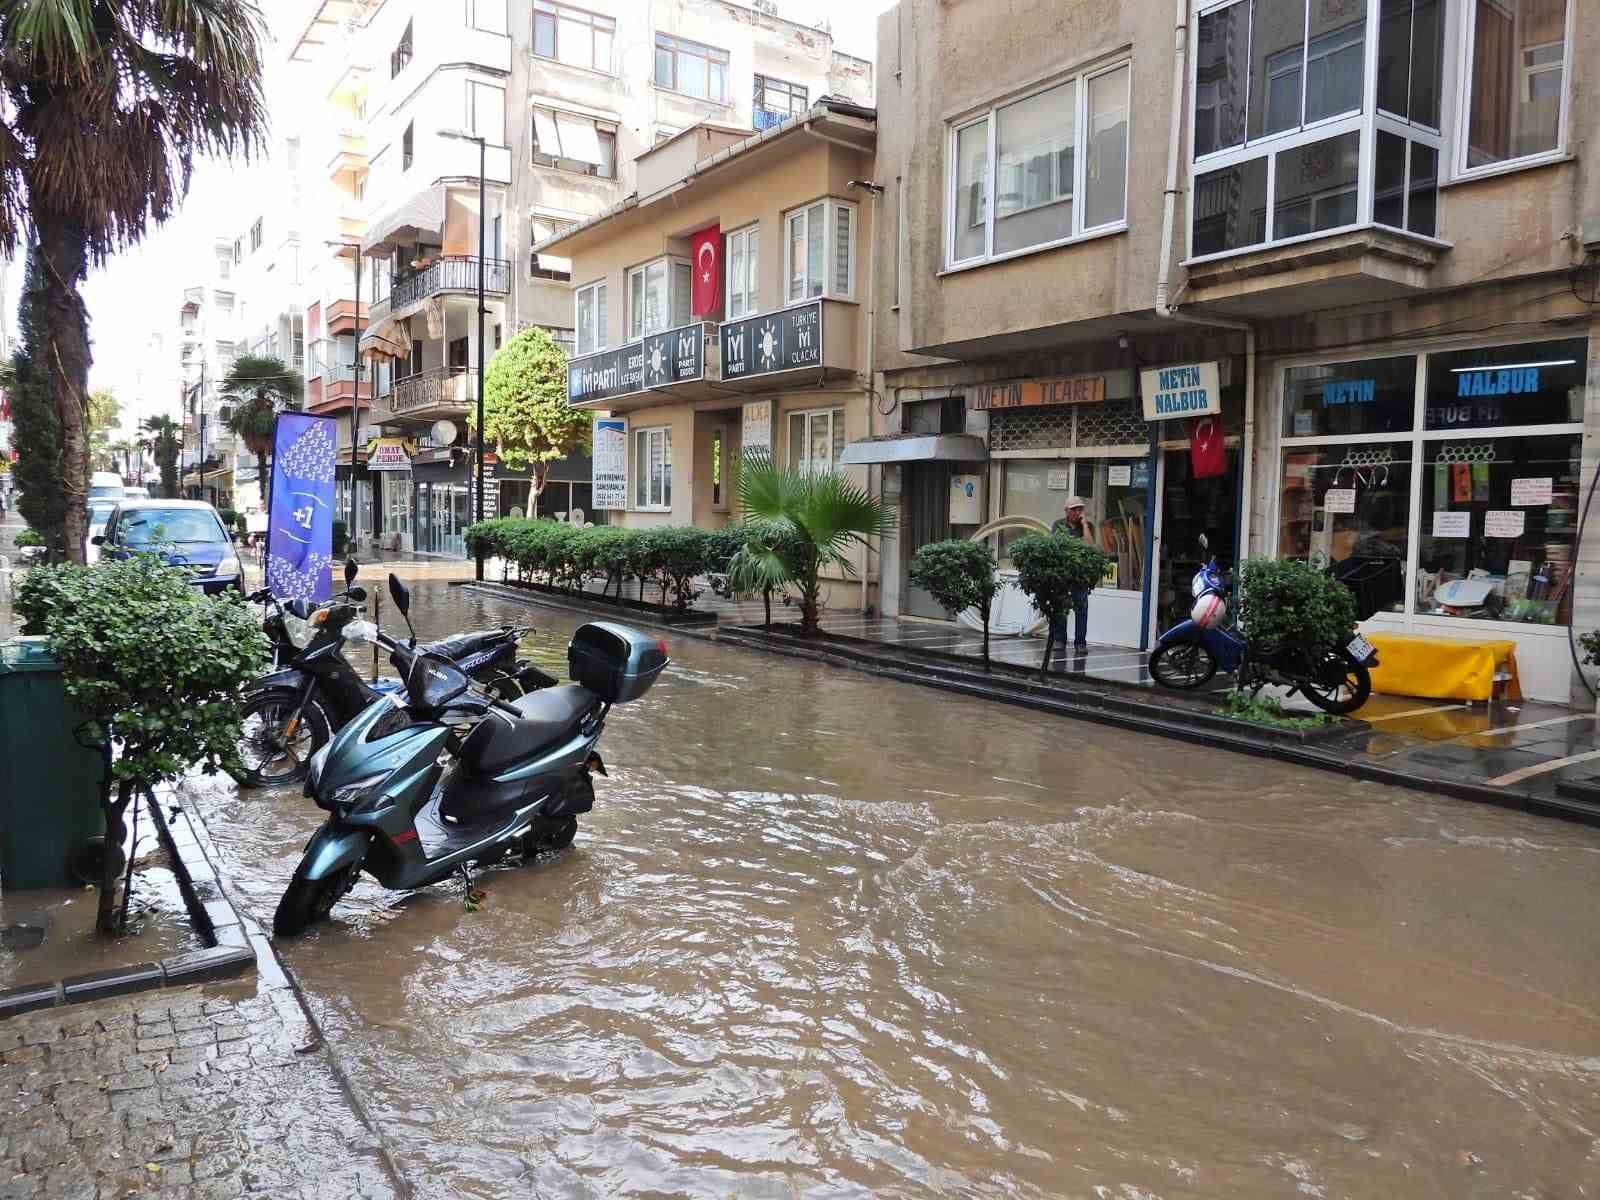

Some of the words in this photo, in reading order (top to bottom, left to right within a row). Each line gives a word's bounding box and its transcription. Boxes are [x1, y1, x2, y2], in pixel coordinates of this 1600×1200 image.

[678, 329, 696, 357] İYİ
[727, 326, 744, 361] İYİ
[798, 326, 811, 348] İYİ
[791, 348, 818, 363] OLACAK
[594, 362, 617, 391] PARTİ
[1458, 368, 1539, 396] NALBUR
[1155, 388, 1208, 414] NALBUR
